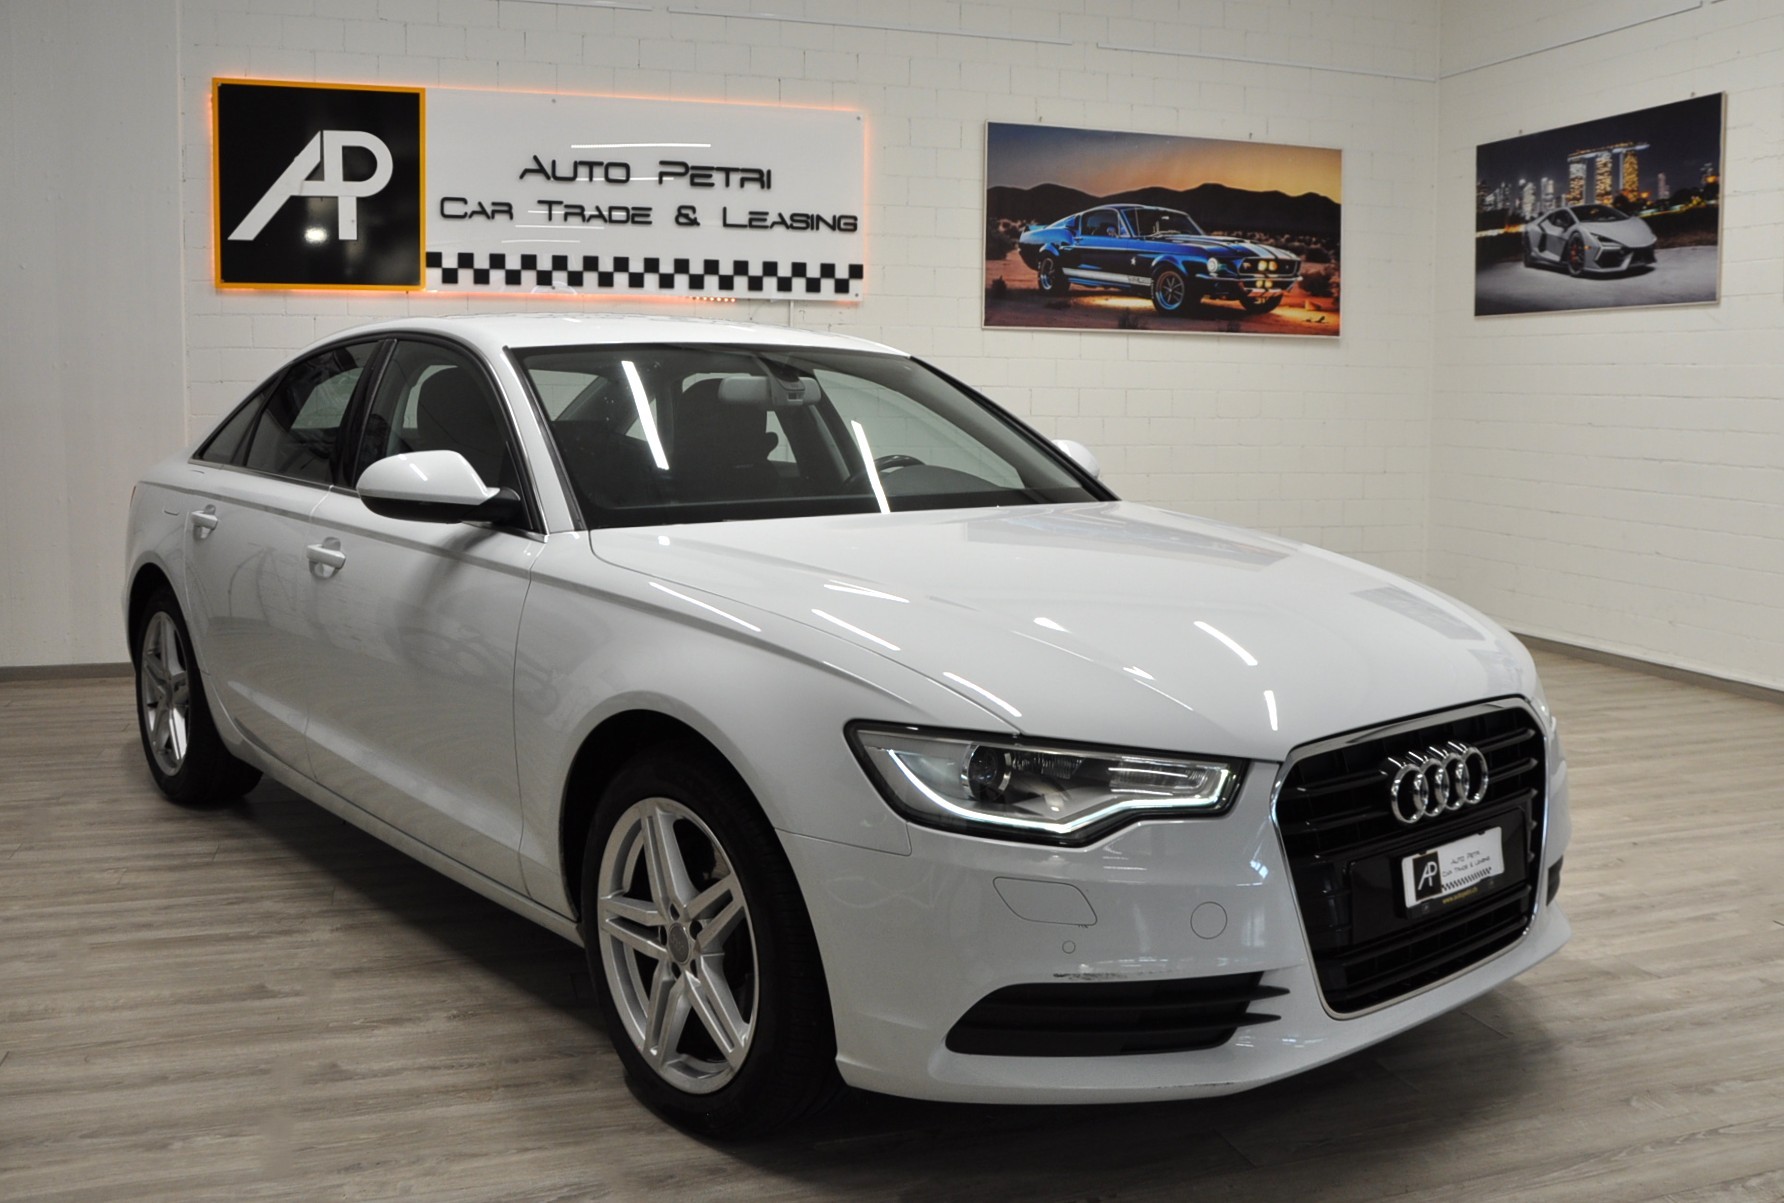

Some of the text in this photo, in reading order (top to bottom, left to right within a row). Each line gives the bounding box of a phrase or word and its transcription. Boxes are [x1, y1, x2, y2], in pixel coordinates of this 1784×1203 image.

[227, 130, 393, 240] AP
[519, 154, 772, 190] AUTO PETRI
[440, 196, 858, 232] CAR TRADE & LEASING
[1417, 861, 1438, 891] AP
